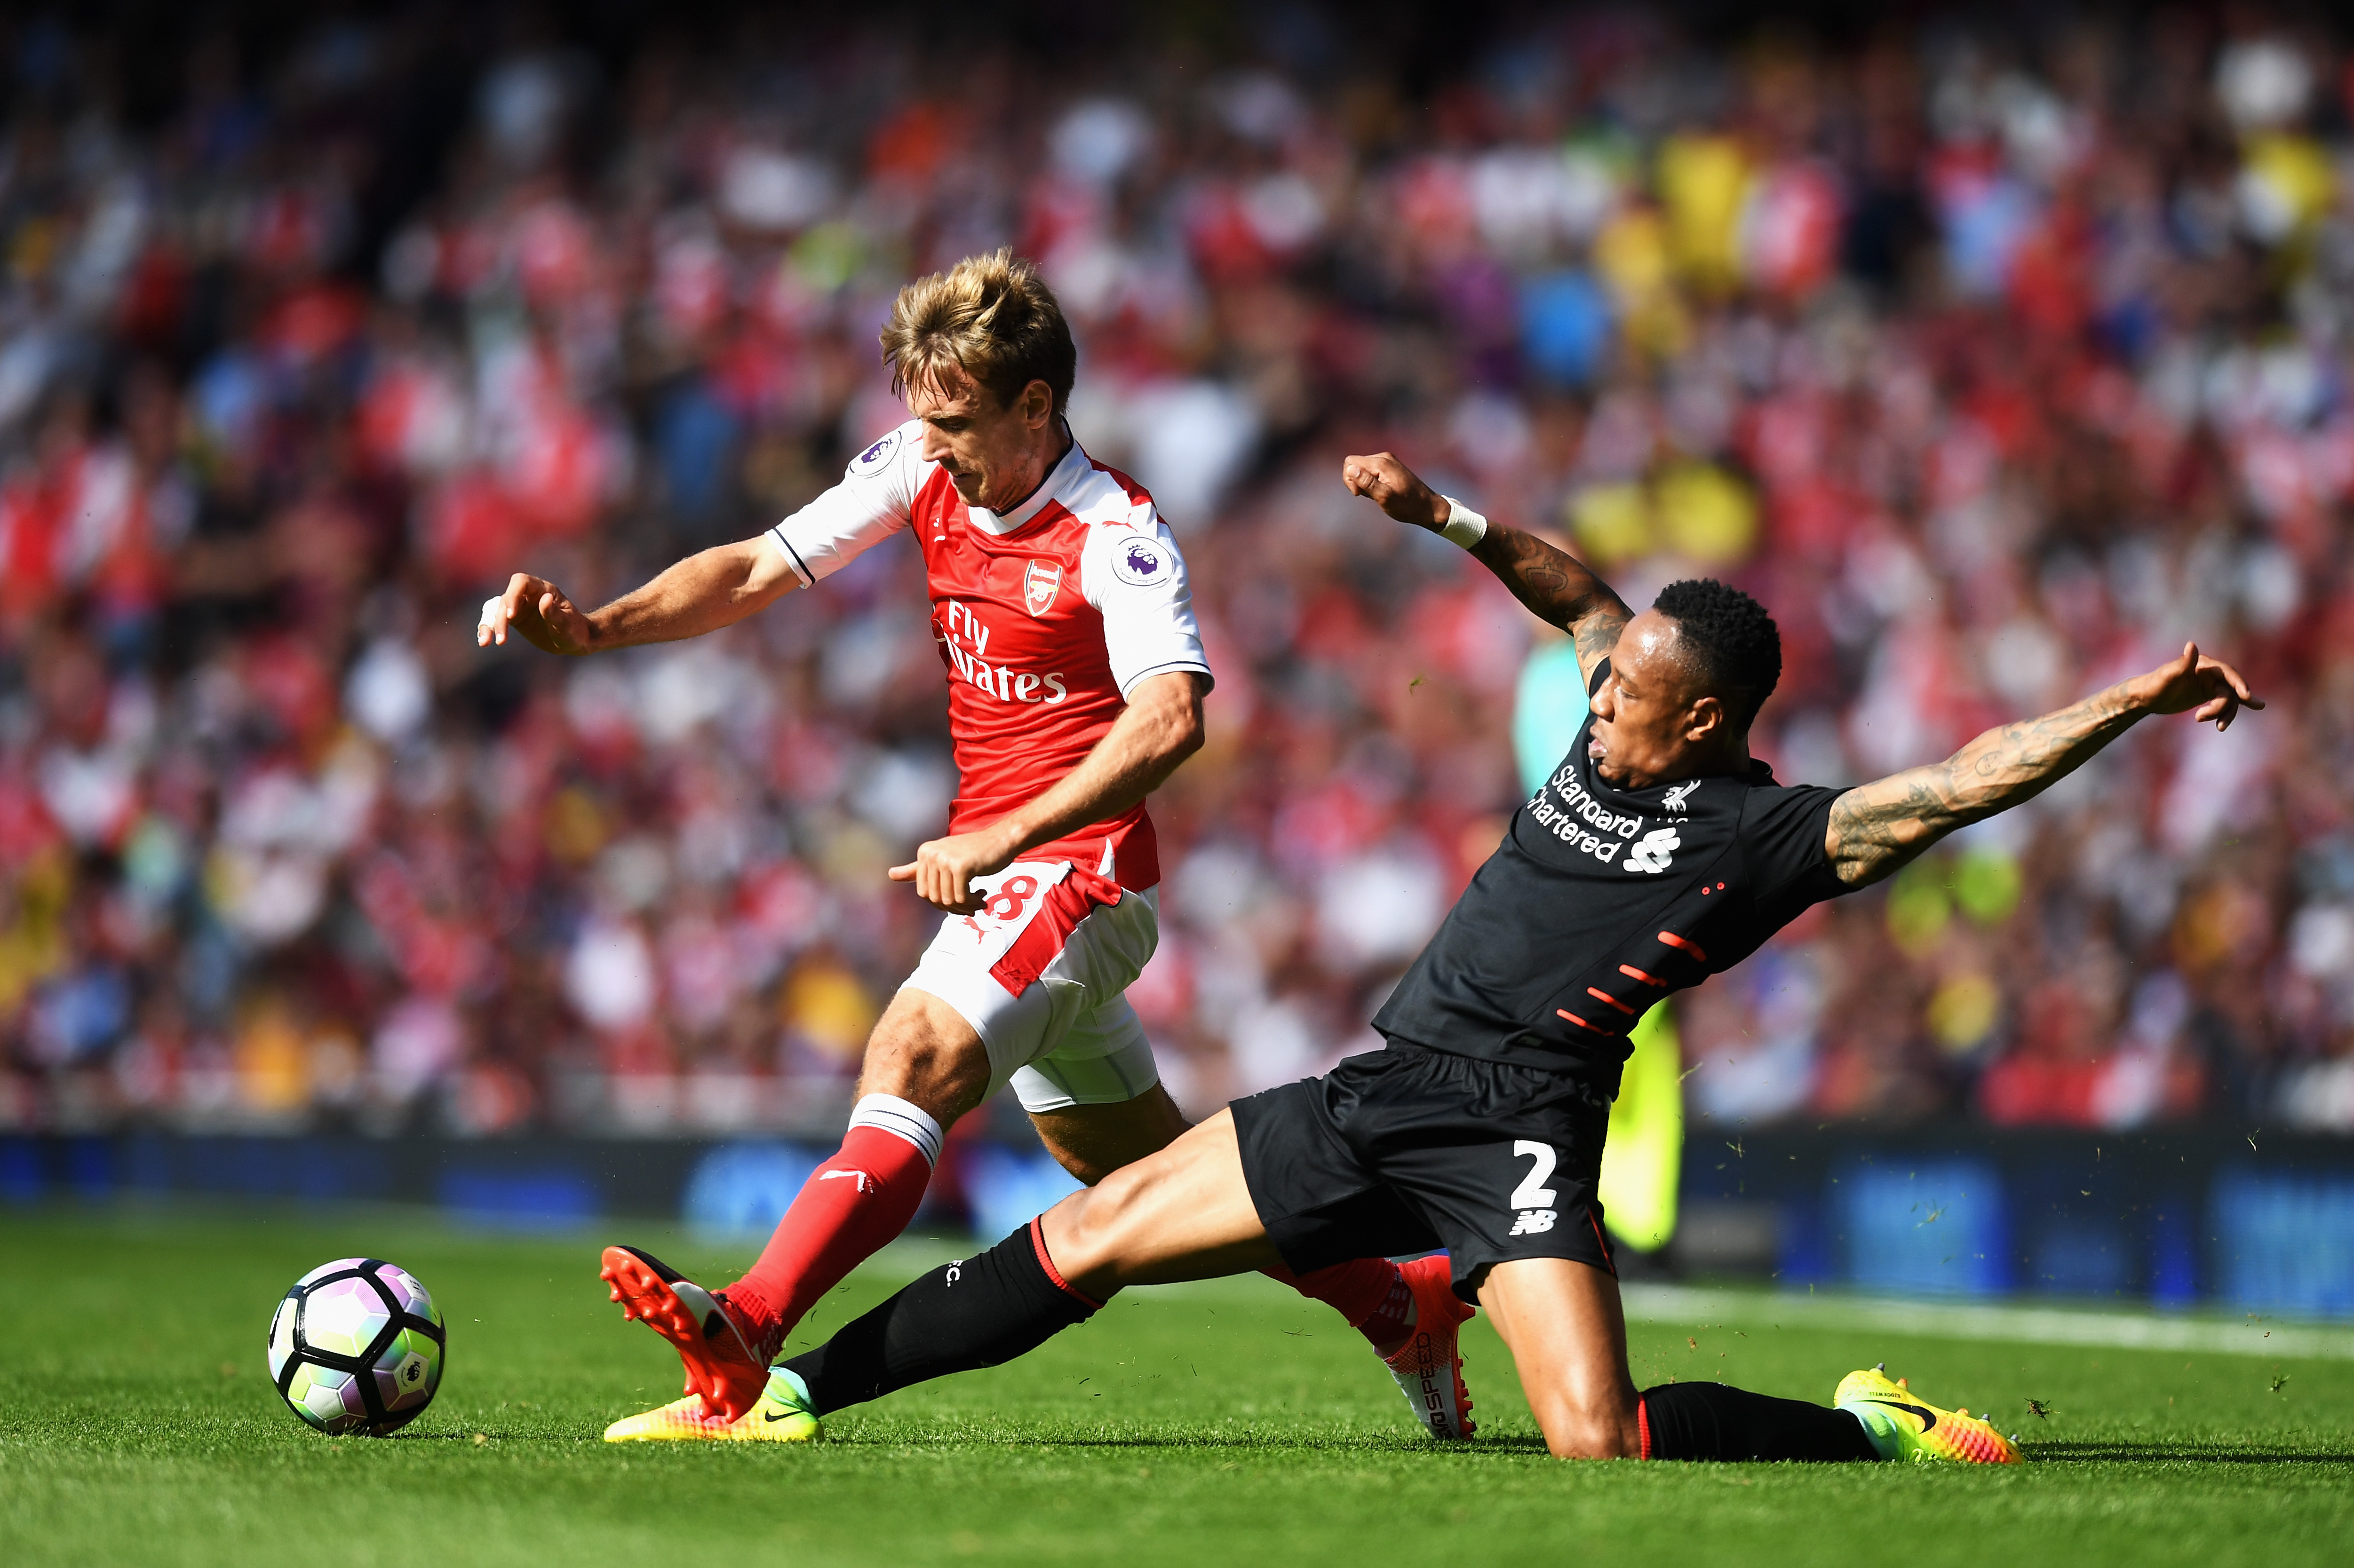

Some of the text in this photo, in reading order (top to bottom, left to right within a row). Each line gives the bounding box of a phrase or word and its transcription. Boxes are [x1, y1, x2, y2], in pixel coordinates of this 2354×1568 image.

[948, 597, 989, 655] Fly
[943, 631, 1067, 704] irates
[1551, 764, 1643, 839] Standard
[1511, 1140, 1557, 1210] 2
